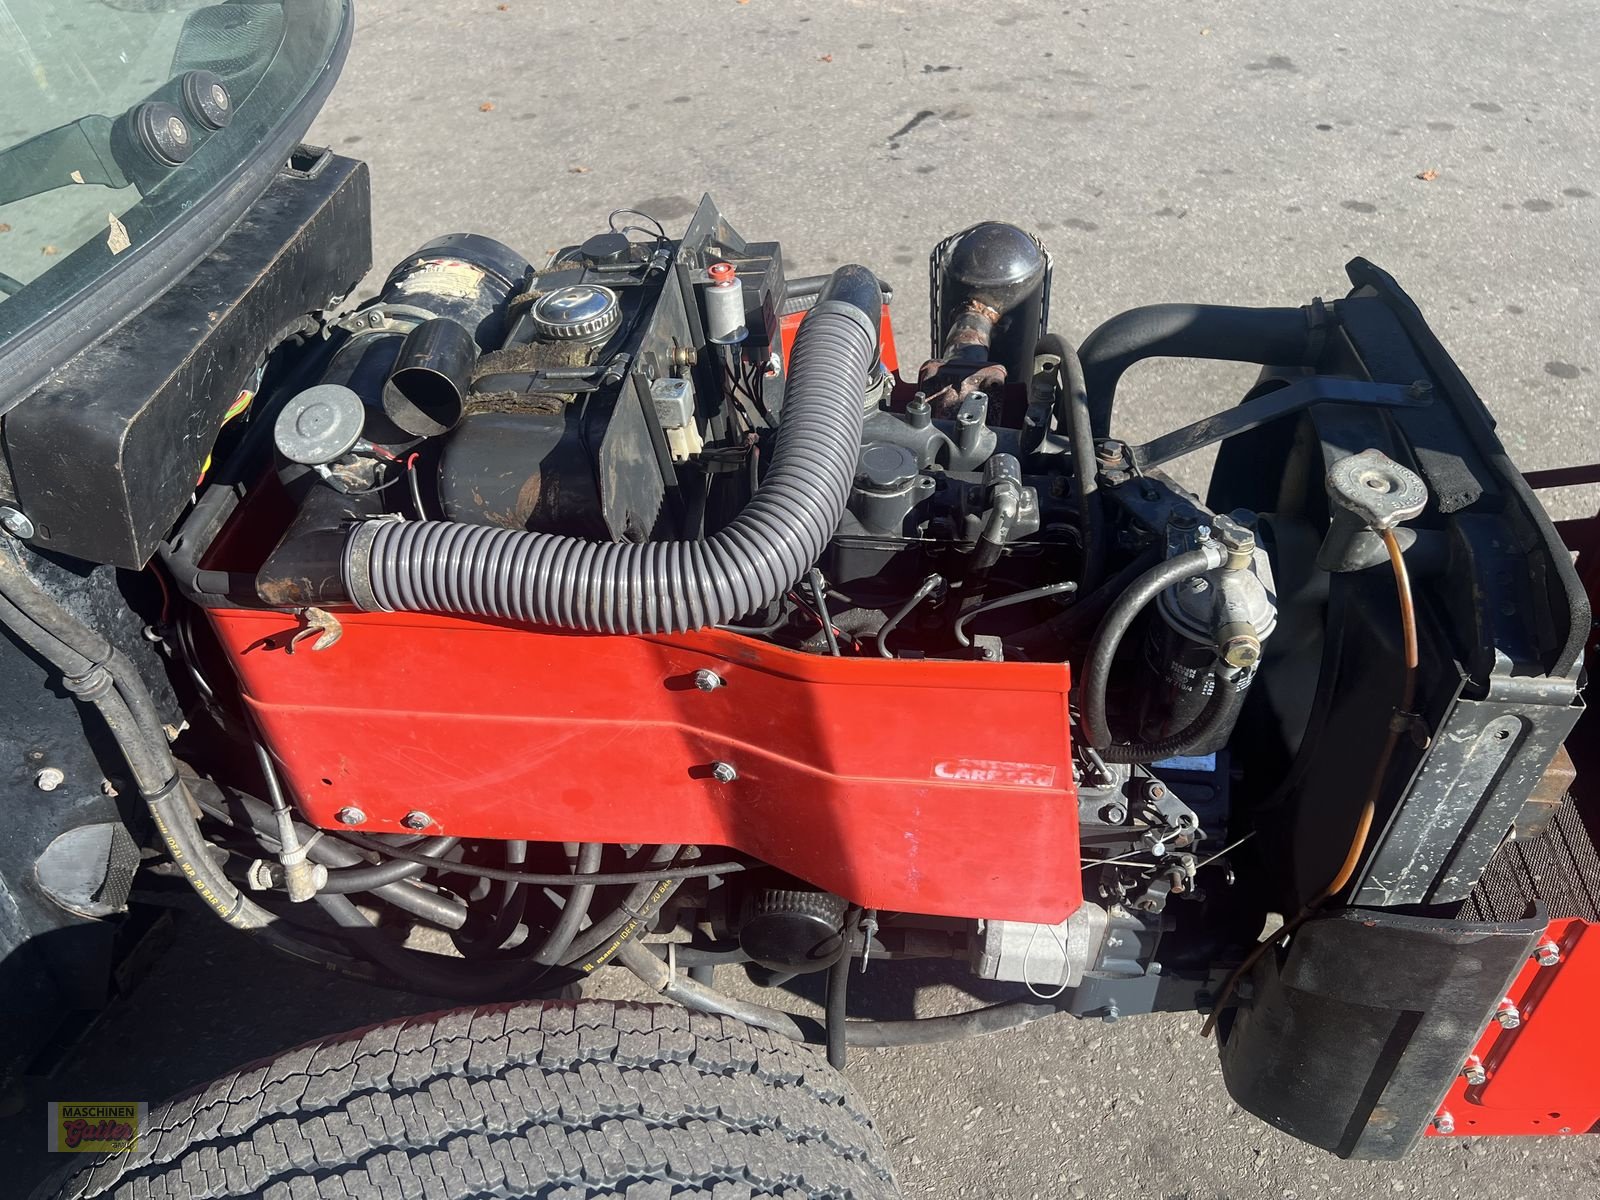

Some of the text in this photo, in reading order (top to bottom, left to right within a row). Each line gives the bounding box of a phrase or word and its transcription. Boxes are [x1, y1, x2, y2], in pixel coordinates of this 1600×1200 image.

[1171, 661, 1197, 674] MANN
[1171, 665, 1196, 679] FILTER
[194, 879, 205, 890] 20
[201, 886, 219, 905] BAR
[651, 892, 661, 903] 20
